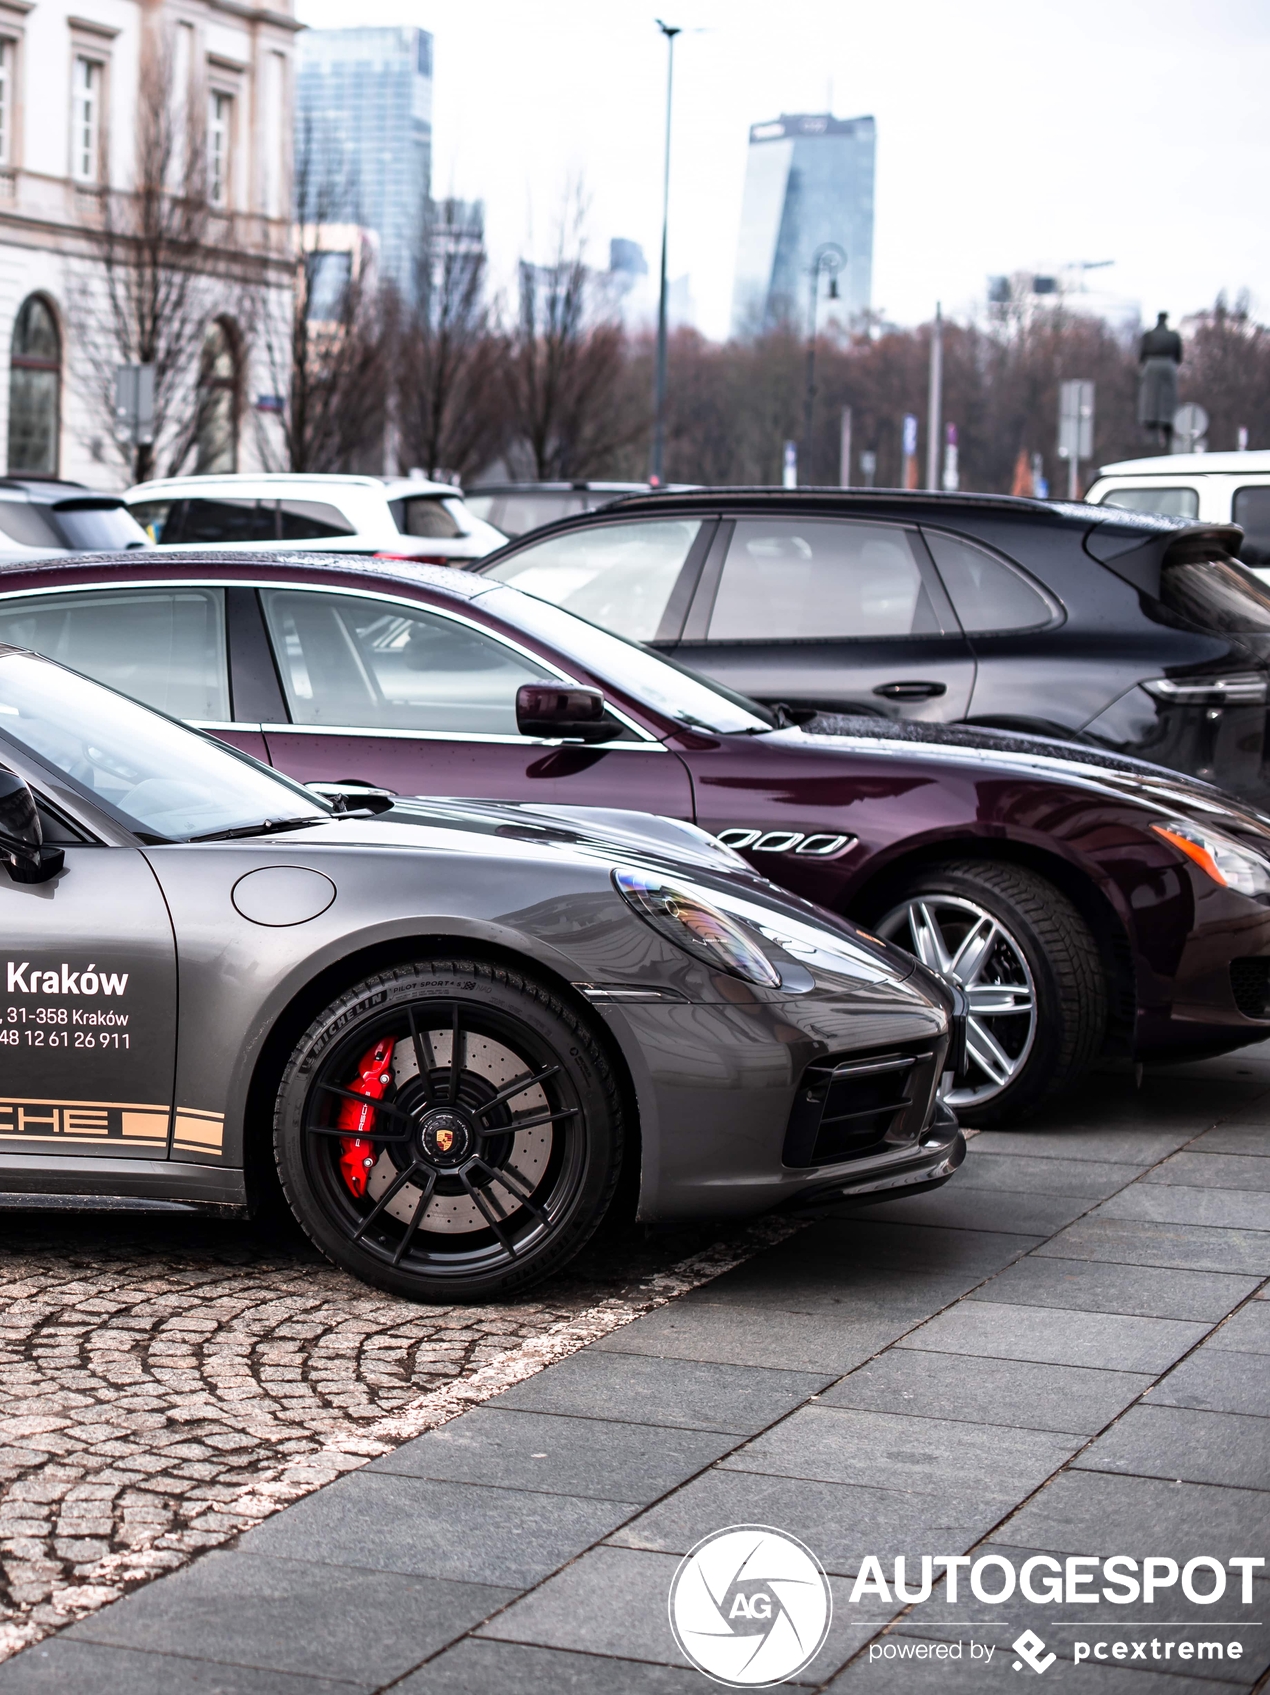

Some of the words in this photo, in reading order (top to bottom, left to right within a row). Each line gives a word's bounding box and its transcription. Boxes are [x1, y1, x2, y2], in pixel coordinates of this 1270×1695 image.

[7, 961, 129, 996] Kraków
[393, 983, 417, 994] PILOT
[420, 980, 448, 989] SPORT
[7, 1007, 68, 1025] 31-358
[72, 1009, 129, 1027] Kraków
[312, 992, 385, 1056] MICHELIN
[24, 1031, 45, 1046] 12
[48, 1031, 68, 1047] 61
[74, 1032, 96, 1048] 26
[99, 1033, 130, 1049] 911
